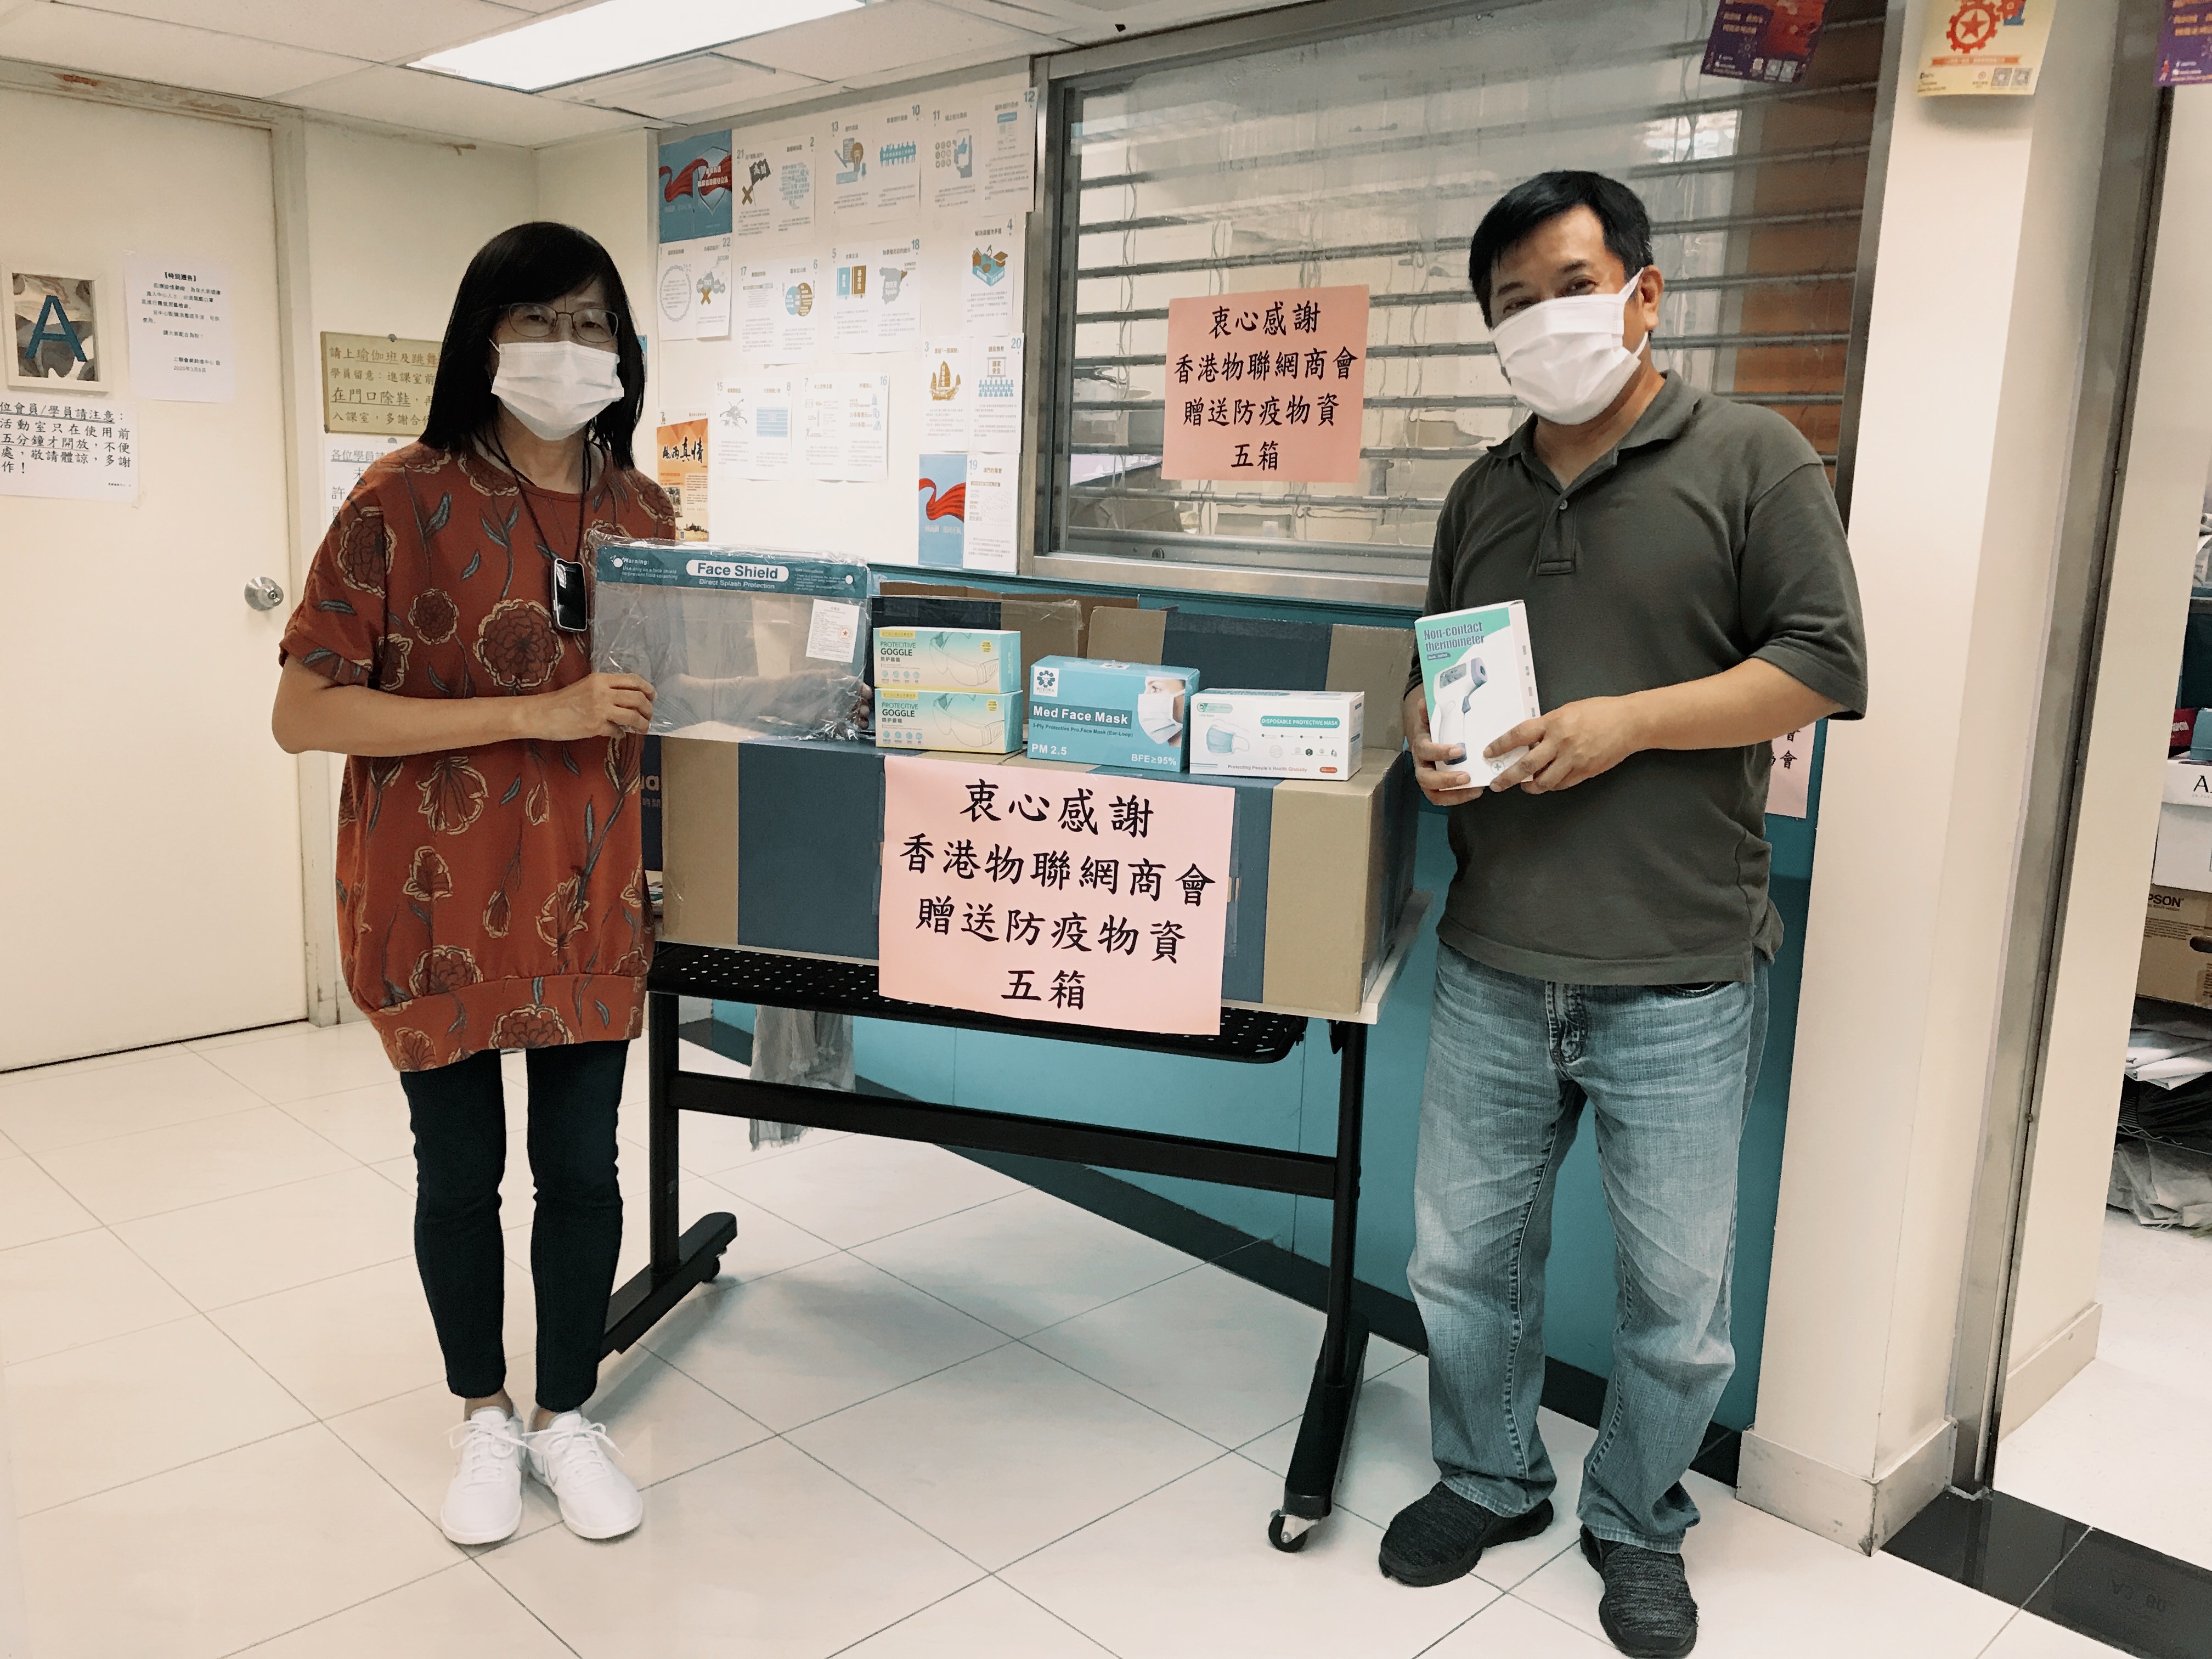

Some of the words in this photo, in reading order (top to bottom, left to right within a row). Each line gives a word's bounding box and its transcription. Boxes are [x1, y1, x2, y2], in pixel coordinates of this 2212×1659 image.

[1024, 91, 1035, 102] 12
[912, 104, 920, 116] 10
[933, 110, 940, 120] 11
[832, 121, 838, 132] 13
[810, 137, 814, 147] 2
[737, 149, 744, 159] 21
[1007, 219, 1012, 230] 4
[723, 238, 730, 247] 22
[911, 239, 919, 250] 18
[832, 249, 836, 259] 5
[814, 259, 818, 269] 6
[741, 266, 747, 276] 17
[1208, 300, 1321, 339] 衷心感謝
[25, 295, 87, 362] A
[924, 341, 929, 352] 3
[1011, 337, 1021, 349] 20
[1174, 346, 1358, 384] 香港物聯網商會
[787, 381, 791, 391] 8
[804, 378, 809, 387] 7
[880, 375, 888, 386] 16
[716, 382, 723, 391] 15
[1183, 392, 1340, 427] 贈送防疫物資
[1231, 440, 1279, 471] 五箱
[969, 459, 977, 470] 19
[331, 487, 346, 500] 許
[697, 562, 731, 577] Face
[734, 565, 779, 579] Shield
[720, 579, 742, 589] Splash
[743, 582, 776, 590] Protection
[1424, 621, 1482, 641] Non-contact
[1425, 635, 1485, 652] thermometer
[881, 648, 913, 656] GOGGLE
[882, 709, 915, 718] GOGGLE
[1033, 706, 1058, 718] Med
[1062, 708, 1092, 722] Face
[1094, 712, 1128, 725] Mask
[1045, 724, 1070, 732] Protective
[1107, 730, 1133, 738] (Ear-Loop)
[1031, 743, 1048, 754] PM
[1050, 746, 1068, 756] 2.5
[960, 778, 1154, 838] 衷心感謝
[899, 833, 1216, 907] 香港物聯網商會
[915, 895, 1186, 964] 贈送防疫物資
[1001, 969, 1085, 1011] 五箱
